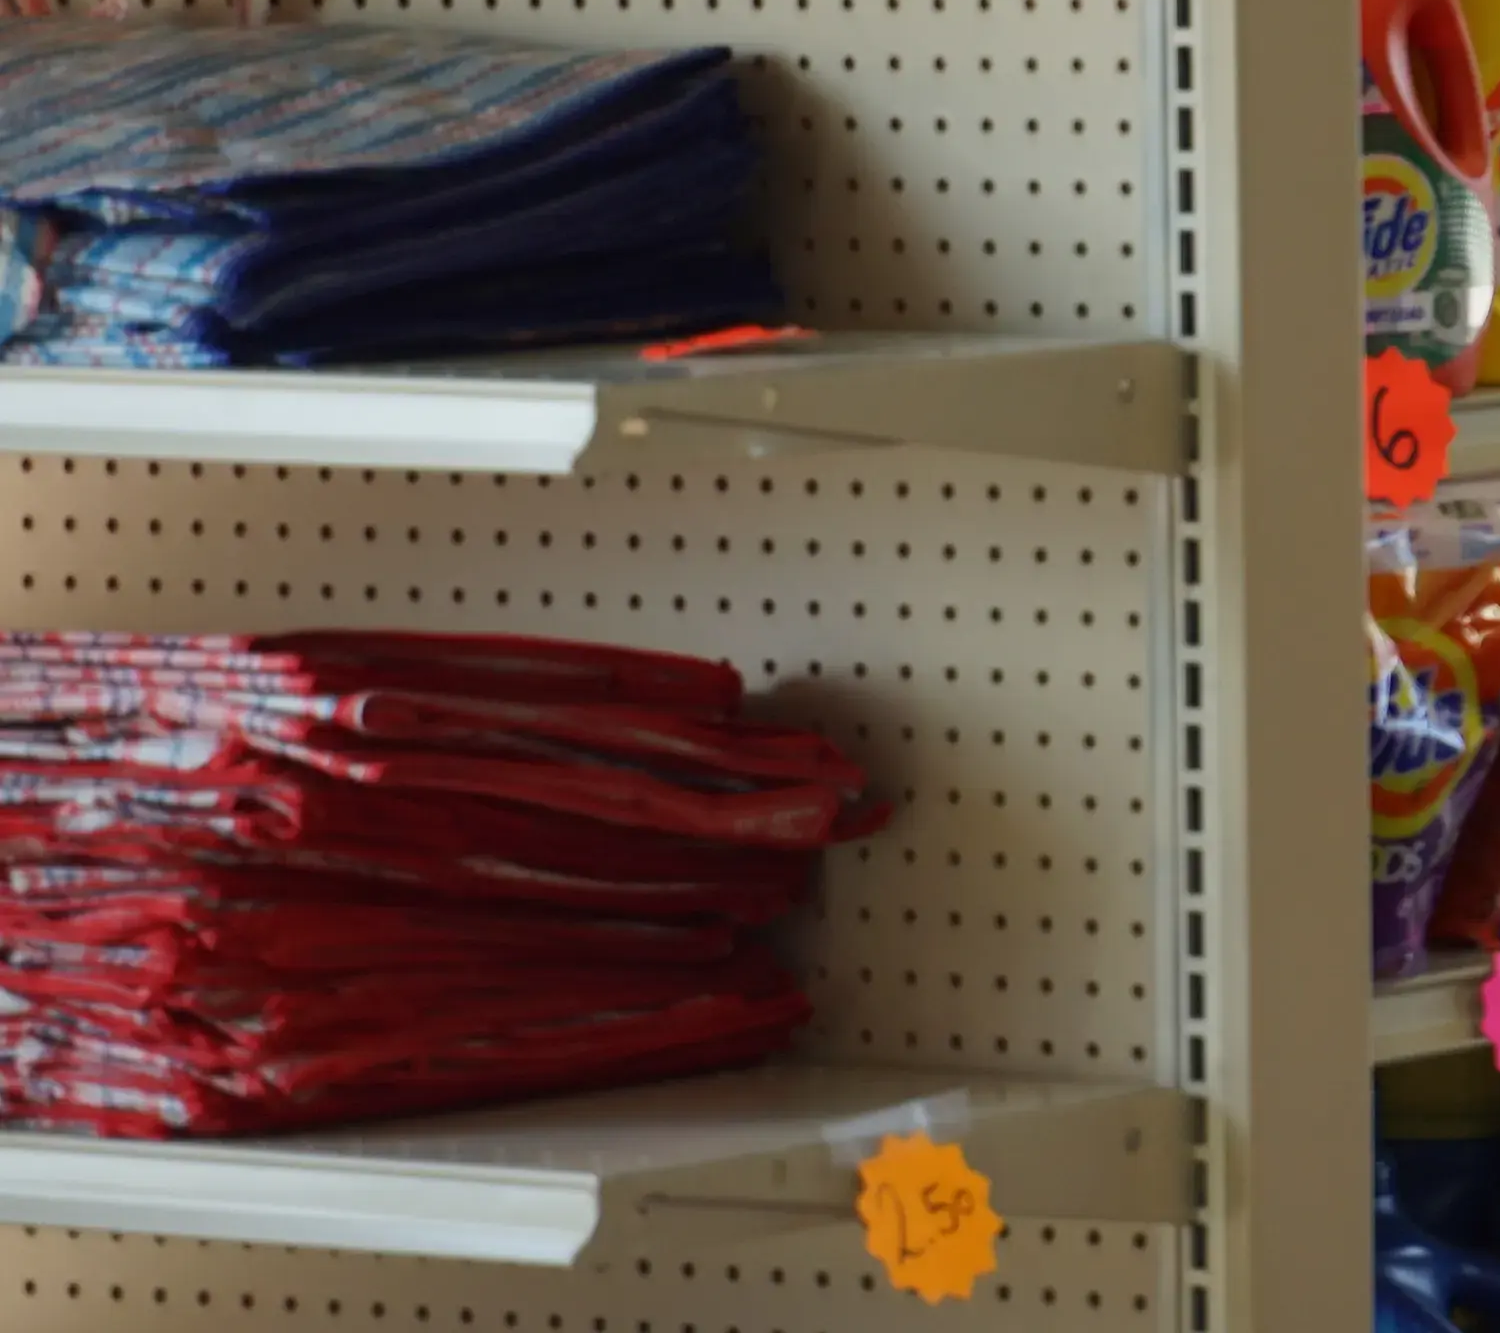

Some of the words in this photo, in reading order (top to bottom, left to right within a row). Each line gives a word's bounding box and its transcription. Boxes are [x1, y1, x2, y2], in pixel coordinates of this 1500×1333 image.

[1362, 195, 1429, 262] ide
[1373, 386, 1418, 469] 6
[1372, 847, 1423, 883] ODS
[877, 1179, 977, 1266] 2.50
